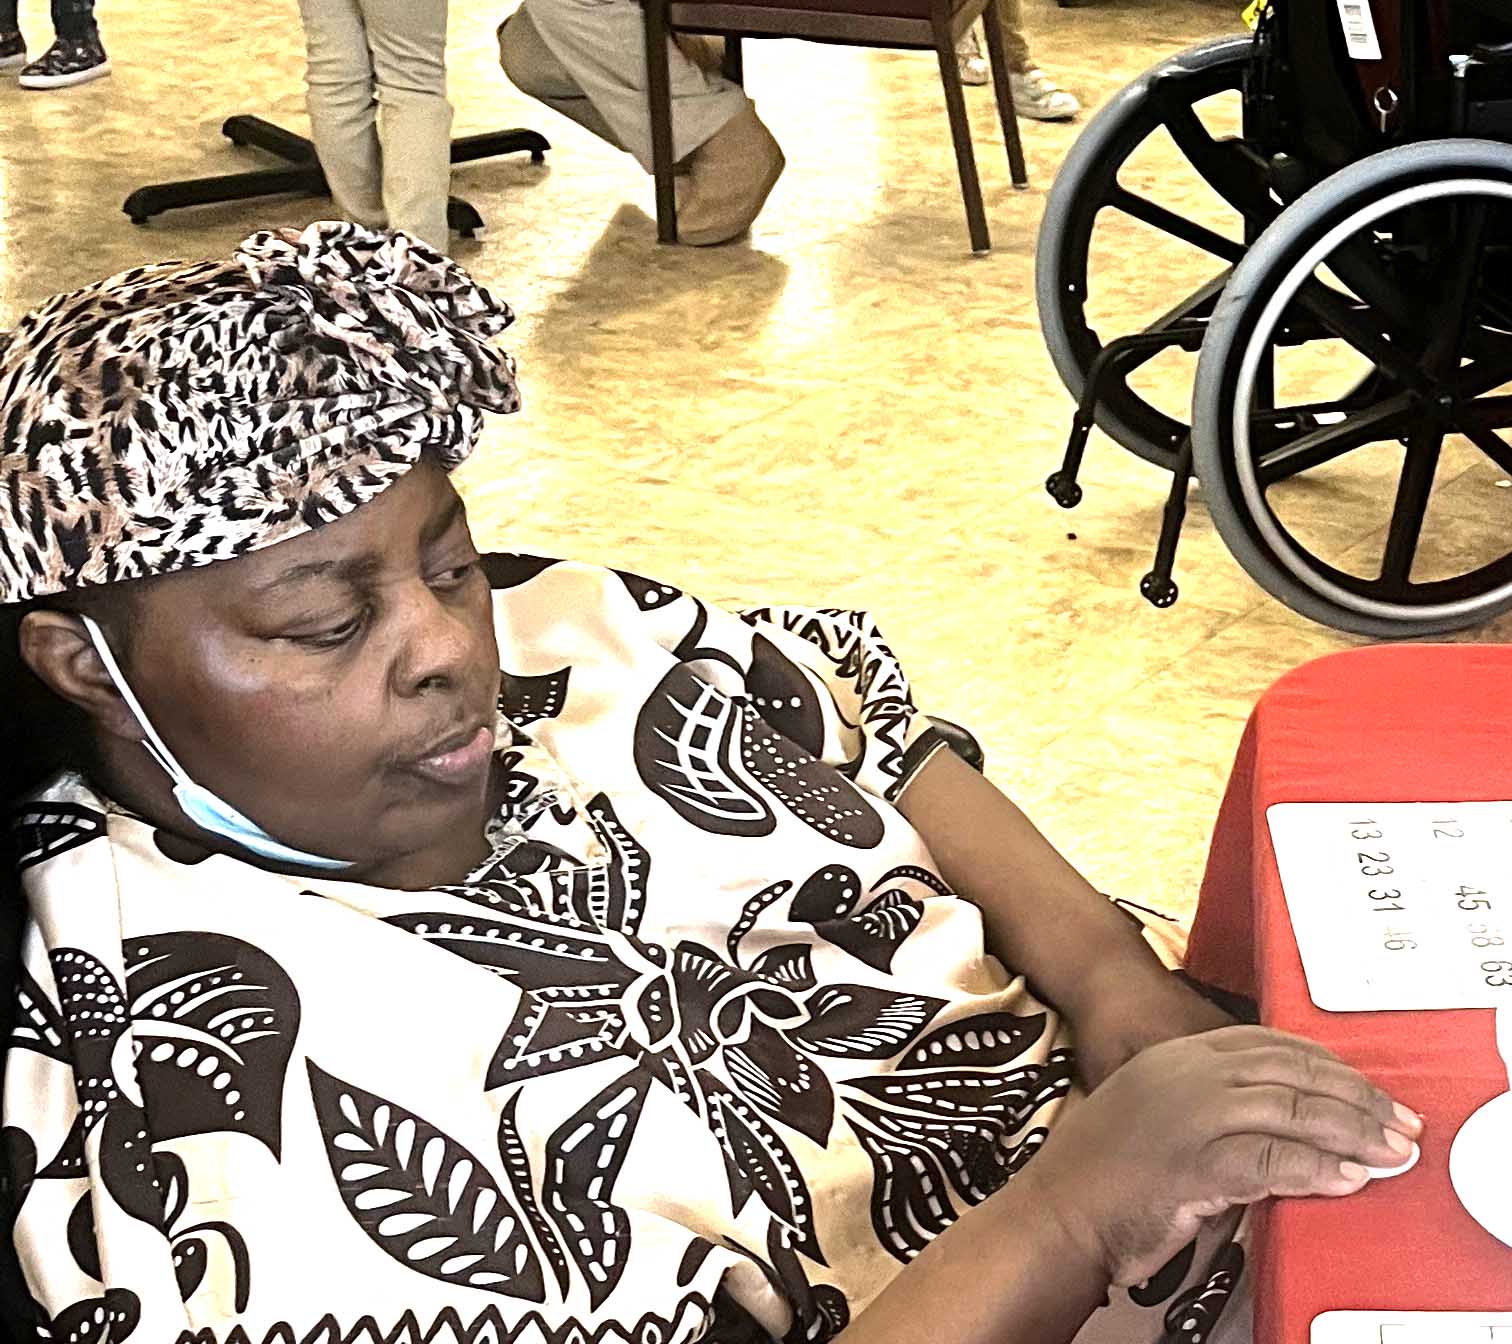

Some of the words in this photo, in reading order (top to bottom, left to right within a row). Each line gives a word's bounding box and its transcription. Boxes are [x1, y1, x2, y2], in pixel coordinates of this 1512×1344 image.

[1349, 820, 1383, 840] 13
[1357, 851, 1395, 877] 23
[1367, 888, 1407, 912] 31
[1454, 885, 1492, 911] 45
